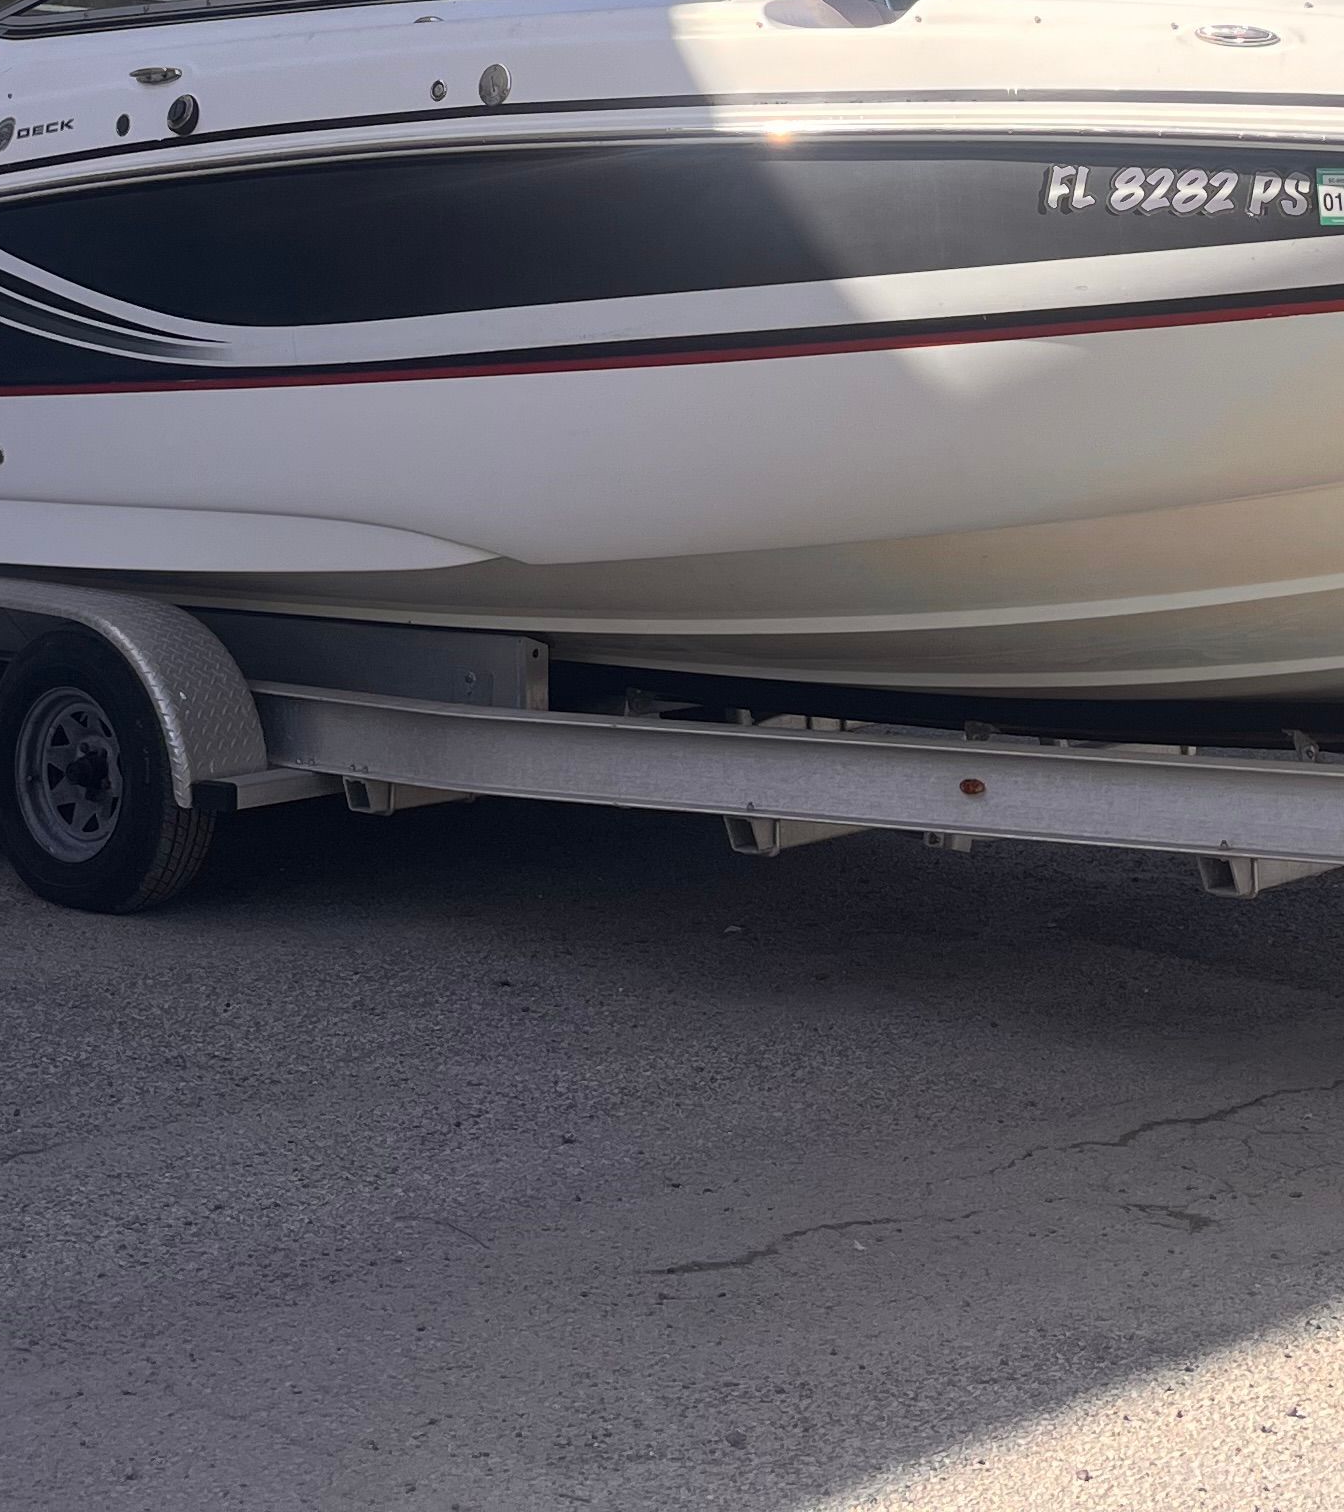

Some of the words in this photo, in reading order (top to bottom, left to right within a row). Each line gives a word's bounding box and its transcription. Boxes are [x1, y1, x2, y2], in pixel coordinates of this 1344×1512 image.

[16, 118, 75, 140] DECK
[1047, 165, 1096, 209] FL
[1109, 166, 1240, 214] 8282
[1248, 171, 1311, 217] PS
[1323, 192, 1343, 212] 01
